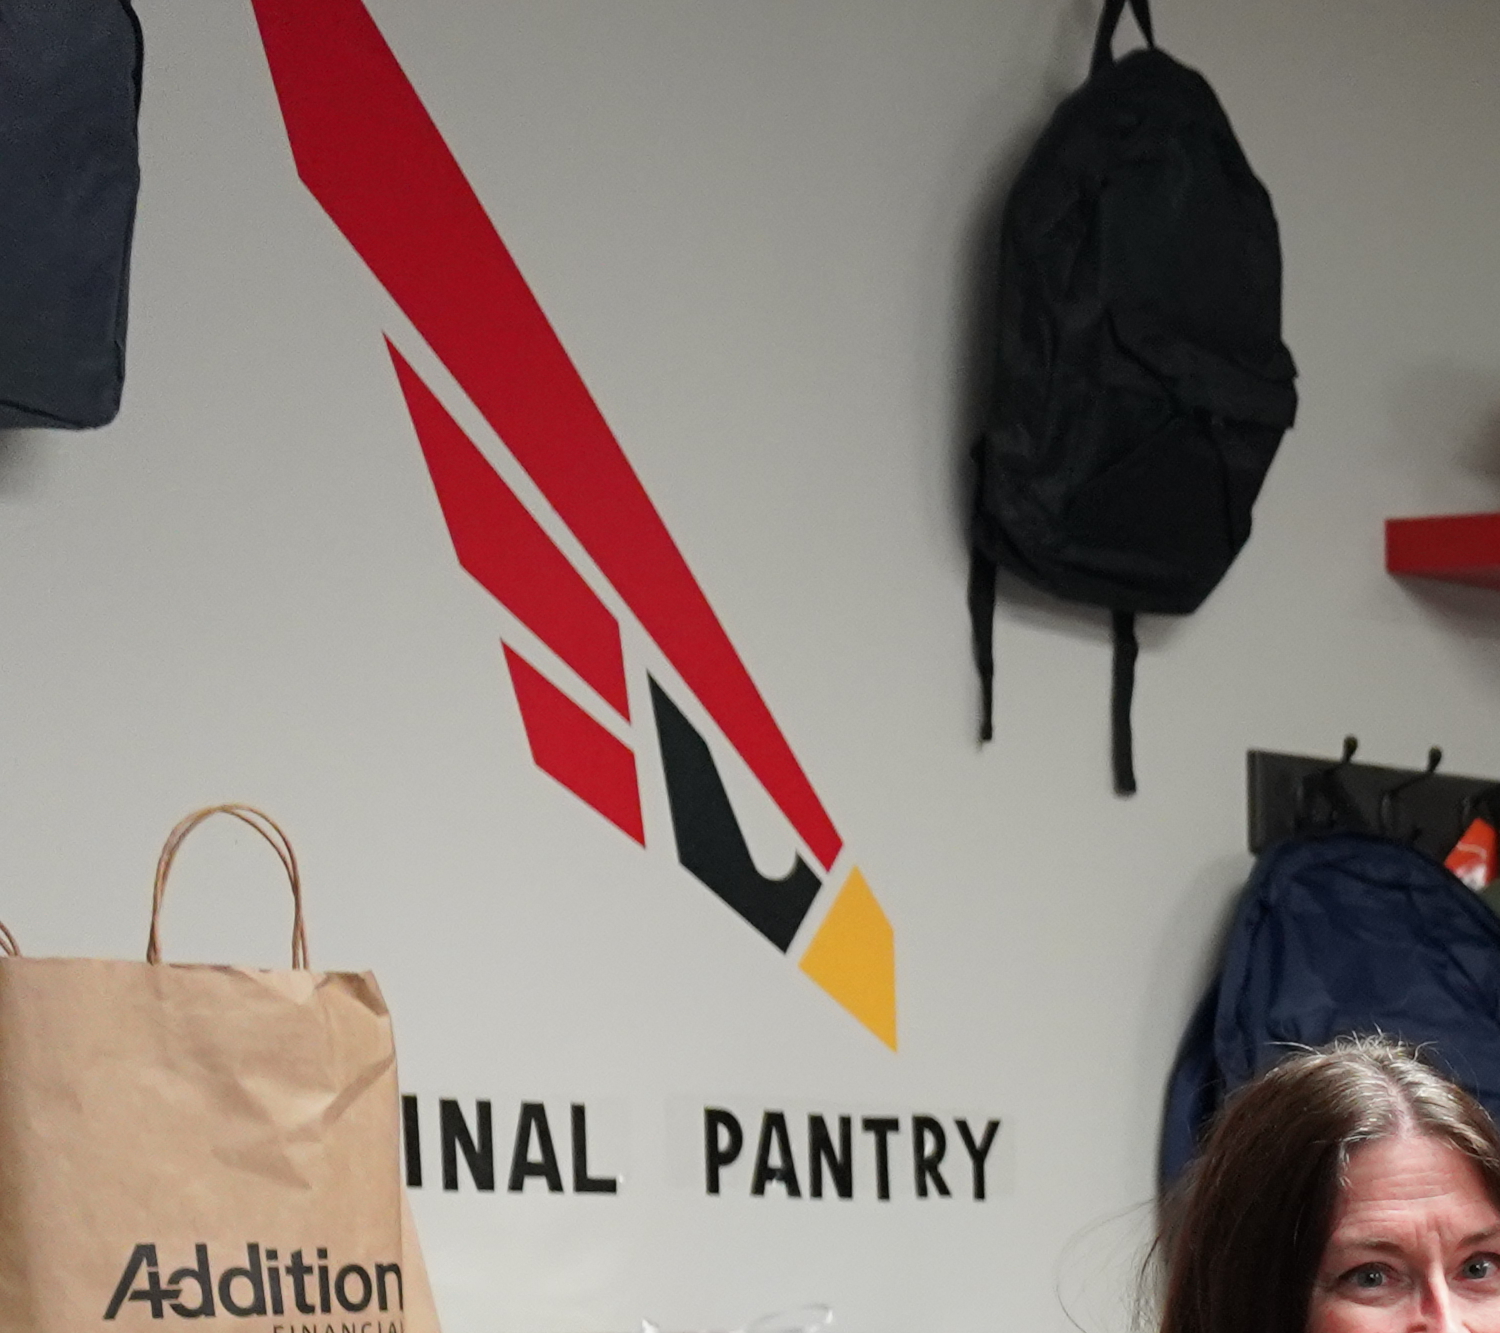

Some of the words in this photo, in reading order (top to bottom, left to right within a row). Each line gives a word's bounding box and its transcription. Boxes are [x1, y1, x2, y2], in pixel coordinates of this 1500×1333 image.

[402, 1093, 618, 1195] INAL
[704, 1107, 1002, 1200] PANTRY
[103, 1241, 404, 1321] Addition
